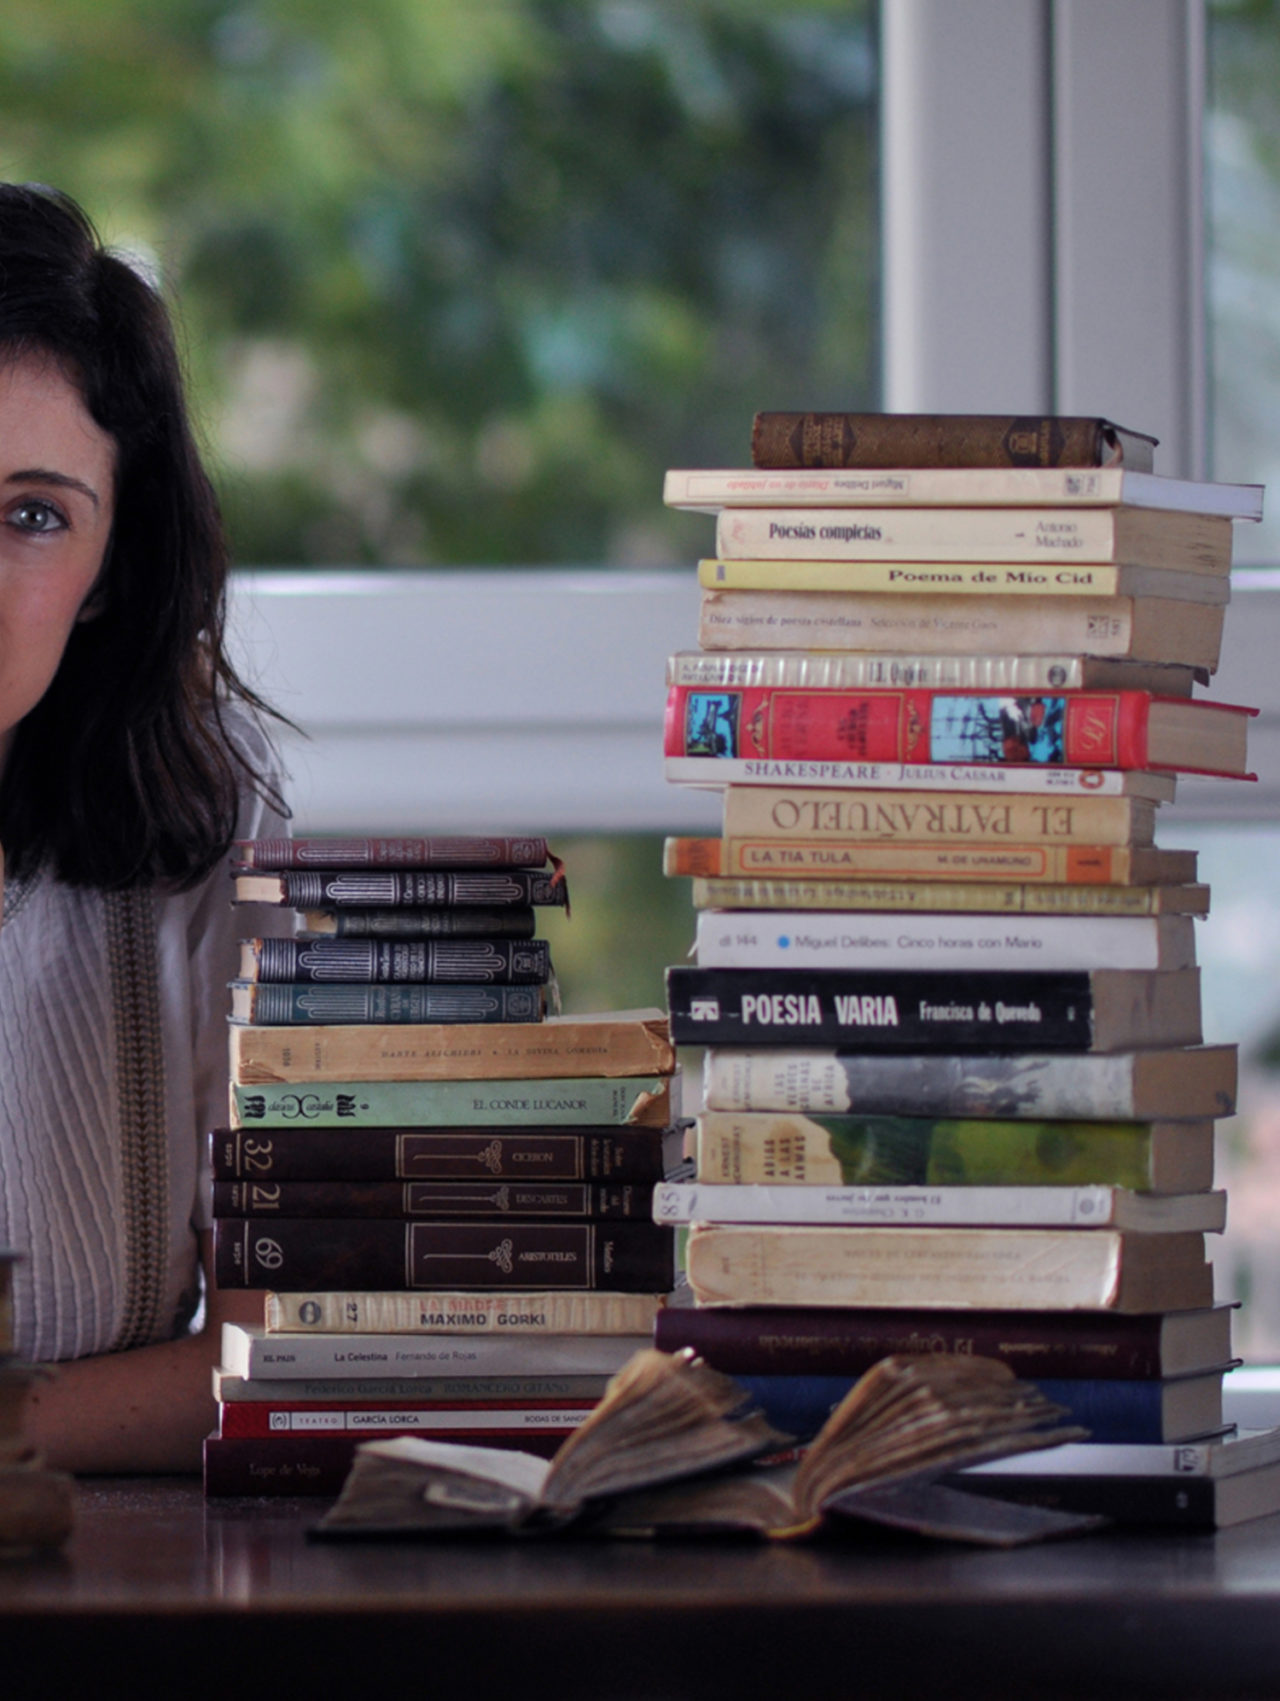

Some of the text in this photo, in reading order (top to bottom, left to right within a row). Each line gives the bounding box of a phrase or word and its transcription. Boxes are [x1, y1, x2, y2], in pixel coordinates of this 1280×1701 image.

[834, 479, 870, 489] Delibes
[871, 478, 905, 490] Miguel
[768, 521, 883, 542] Poesías completas
[1035, 520, 1077, 533] Antonio
[1035, 535, 1083, 548] Machado
[889, 570, 964, 583] Poema
[971, 571, 998, 583] de
[1055, 571, 1094, 585] Cid
[744, 761, 881, 780] SHAKESPEARE
[772, 799, 1075, 838] EL PATRAÑUELO
[751, 851, 853, 865] LA TIA TULA
[952, 856, 969, 865] DE
[971, 856, 1033, 867] UNAMUNO
[795, 935, 838, 950] Miguel
[897, 935, 935, 949] Cinco
[938, 936, 975, 949] horas
[977, 938, 1002, 949] con
[1004, 936, 1043, 950] Mario
[741, 994, 1042, 1026] POESIA VARIA Francisco de Quevedo
[472, 1099, 588, 1111] EL CONDE LUCANOR
[244, 1138, 274, 1173] 32
[252, 1183, 281, 1209] 21
[660, 1191, 680, 1217] 85
[254, 1237, 285, 1270] 69
[518, 1251, 578, 1262] ARISTOTELES
[420, 1297, 441, 1312] LA
[346, 1302, 358, 1323] 27
[420, 1313, 547, 1326] MAXIMO GORKI
[334, 1350, 478, 1364] La Celestina Fernando de Rojas
[304, 1381, 354, 1396] Federico
[397, 1382, 433, 1396] Lorca
[443, 1382, 520, 1396] ROMANCERO
[523, 1381, 571, 1395] GITANO
[299, 1417, 338, 1425] TEATRO
[388, 1414, 421, 1426] LORCA
[524, 1414, 550, 1424] BODAS
[551, 1415, 562, 1424] DE
